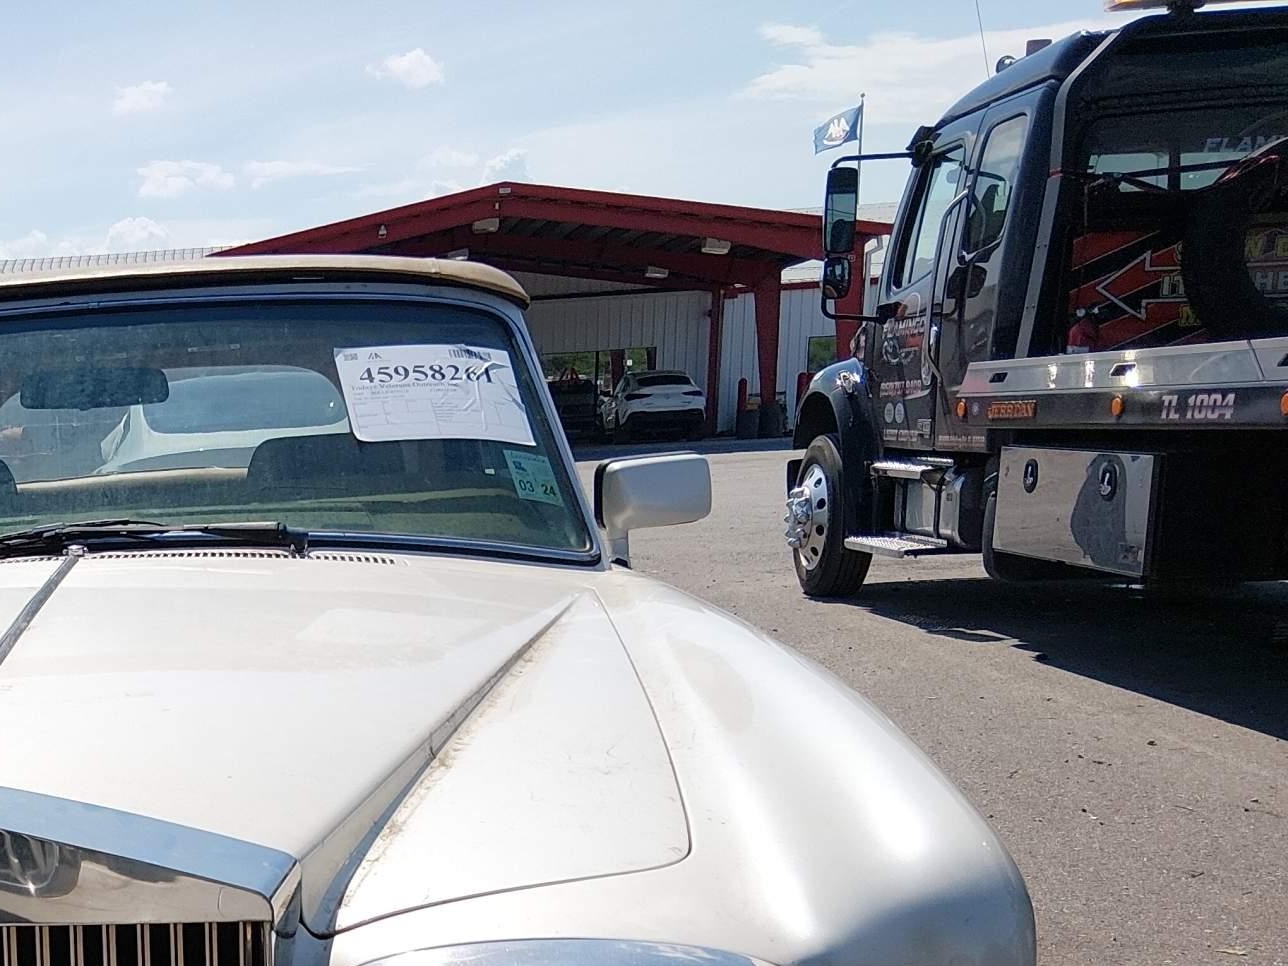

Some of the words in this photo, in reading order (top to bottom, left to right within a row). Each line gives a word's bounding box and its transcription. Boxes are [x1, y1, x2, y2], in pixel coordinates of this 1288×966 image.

[1160, 395, 1181, 419] TL
[1186, 393, 1236, 419] 1004
[518, 479, 535, 493] 03
[541, 484, 557, 497] 24
